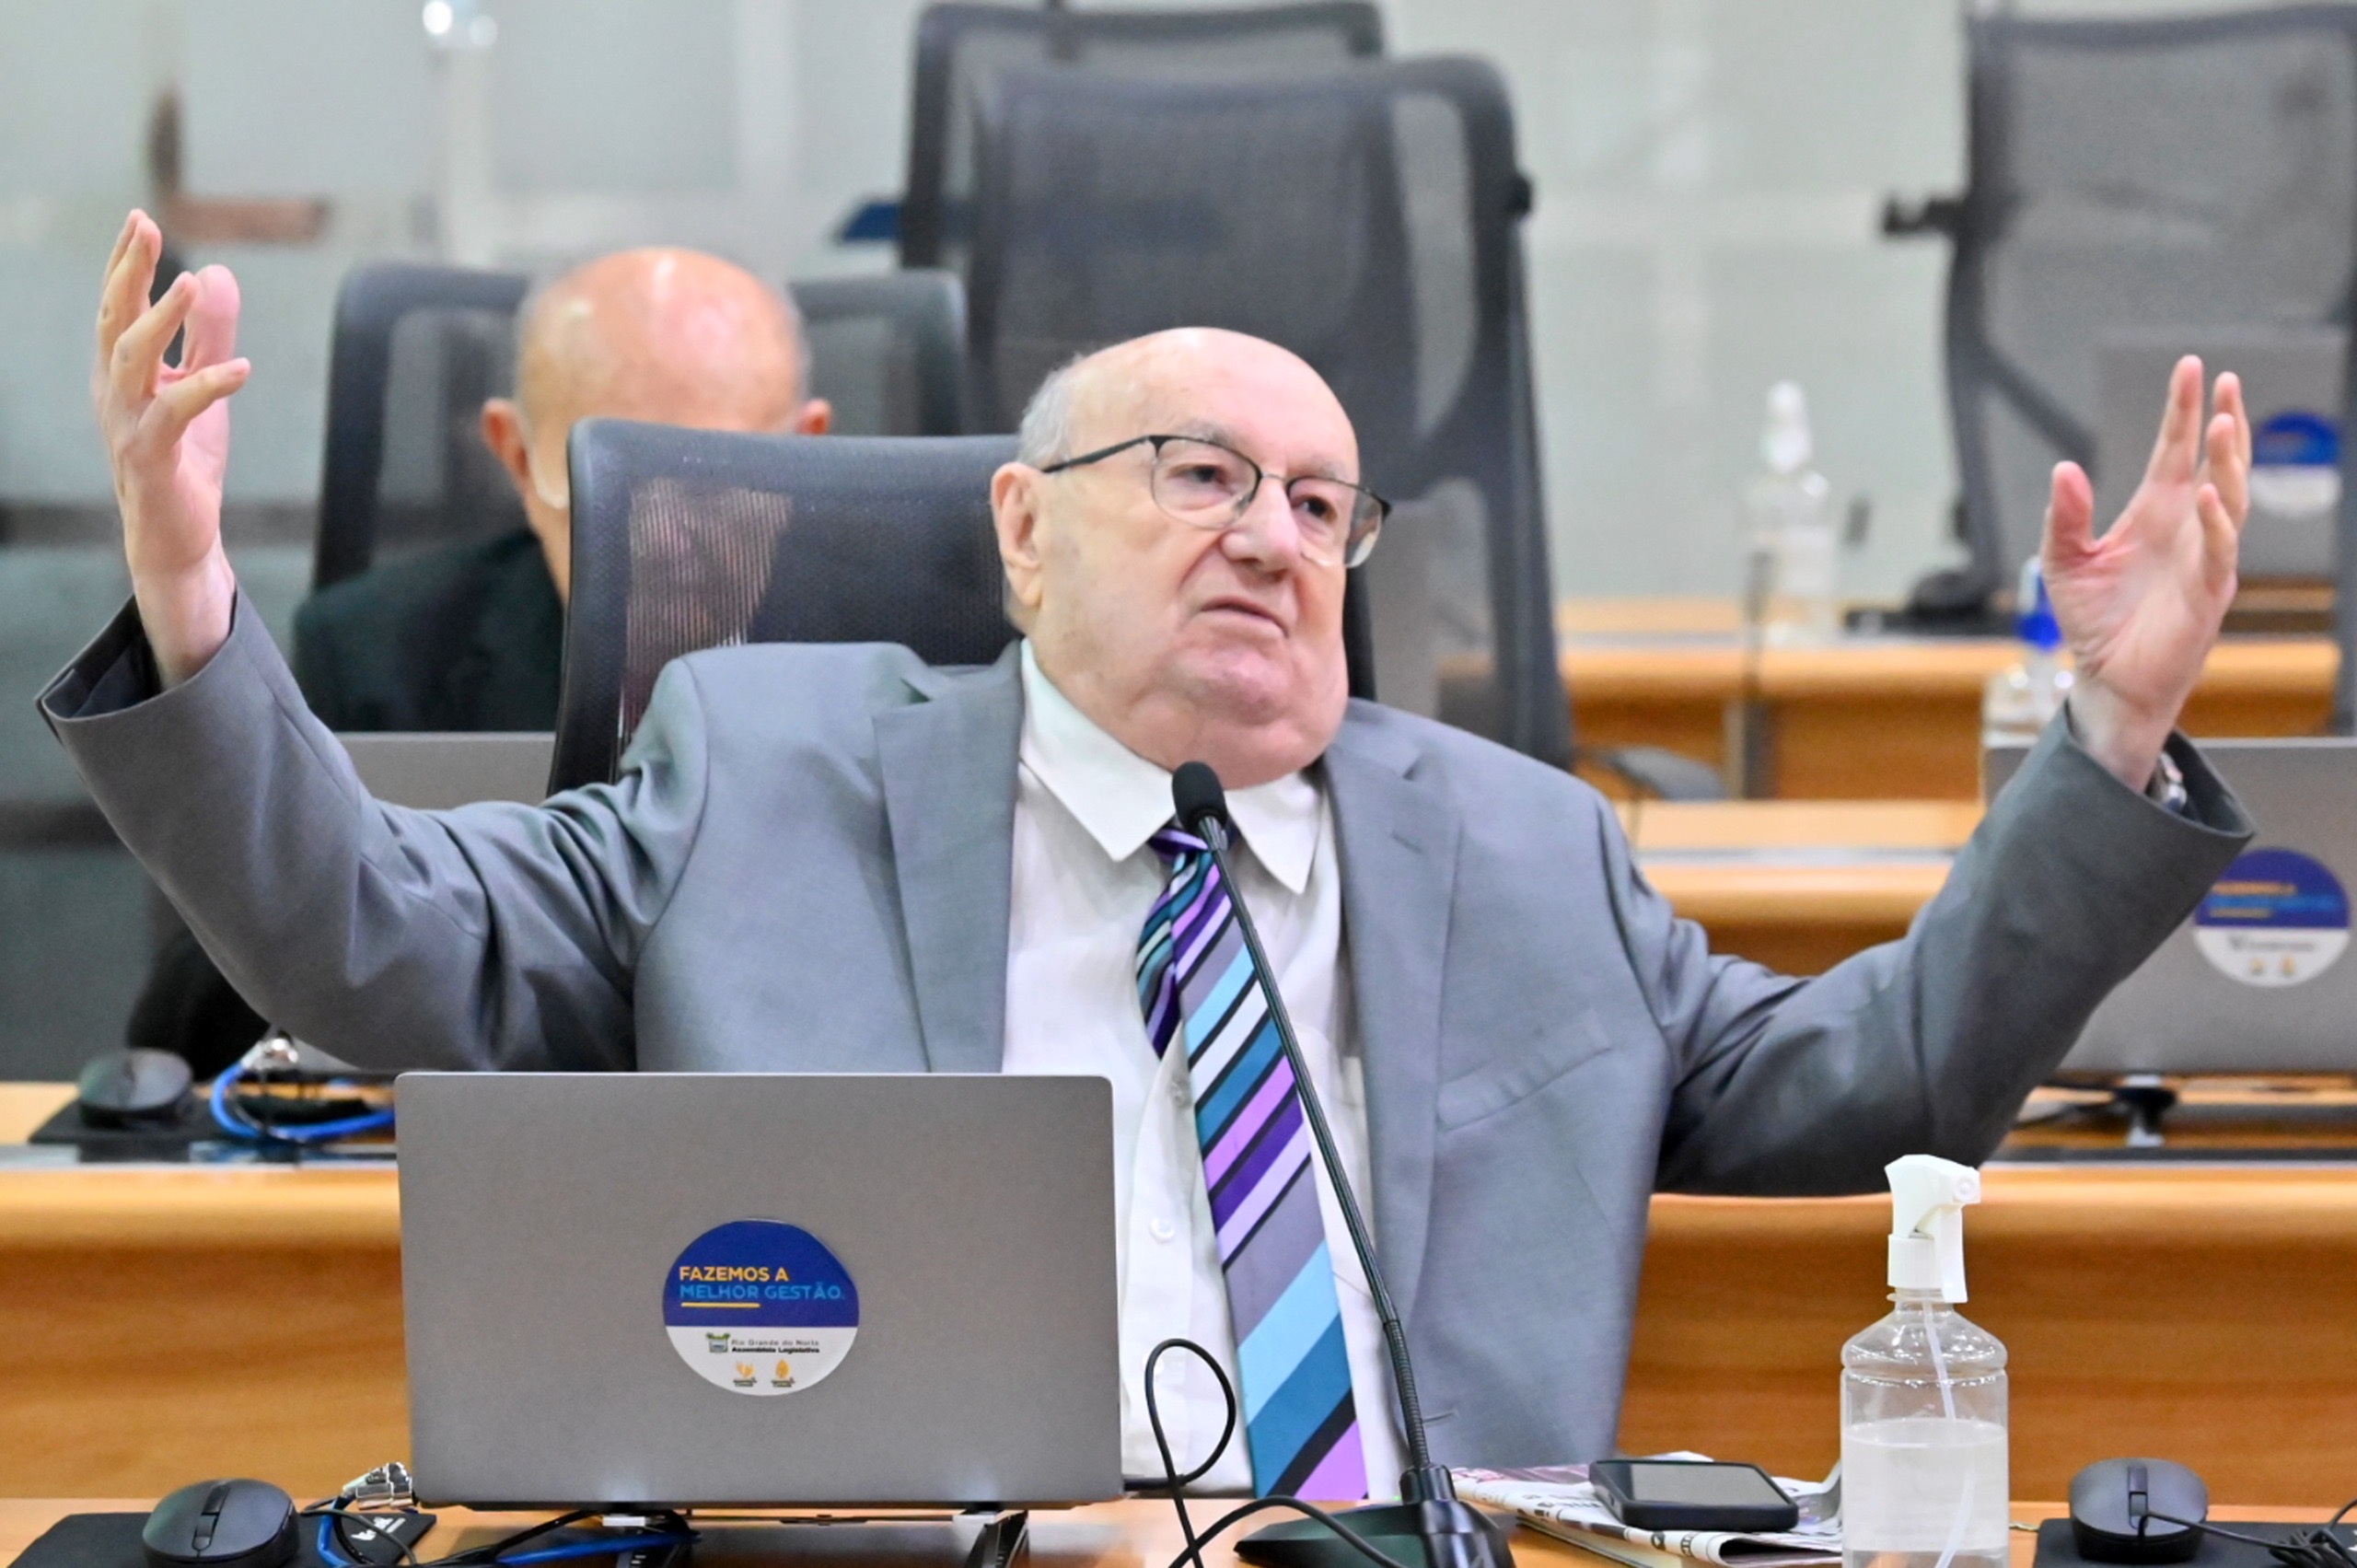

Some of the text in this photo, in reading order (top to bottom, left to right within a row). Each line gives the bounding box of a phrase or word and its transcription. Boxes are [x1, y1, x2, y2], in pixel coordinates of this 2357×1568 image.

[679, 1266, 789, 1282] FAZEMOS A
[679, 1284, 759, 1299] MELHOR
